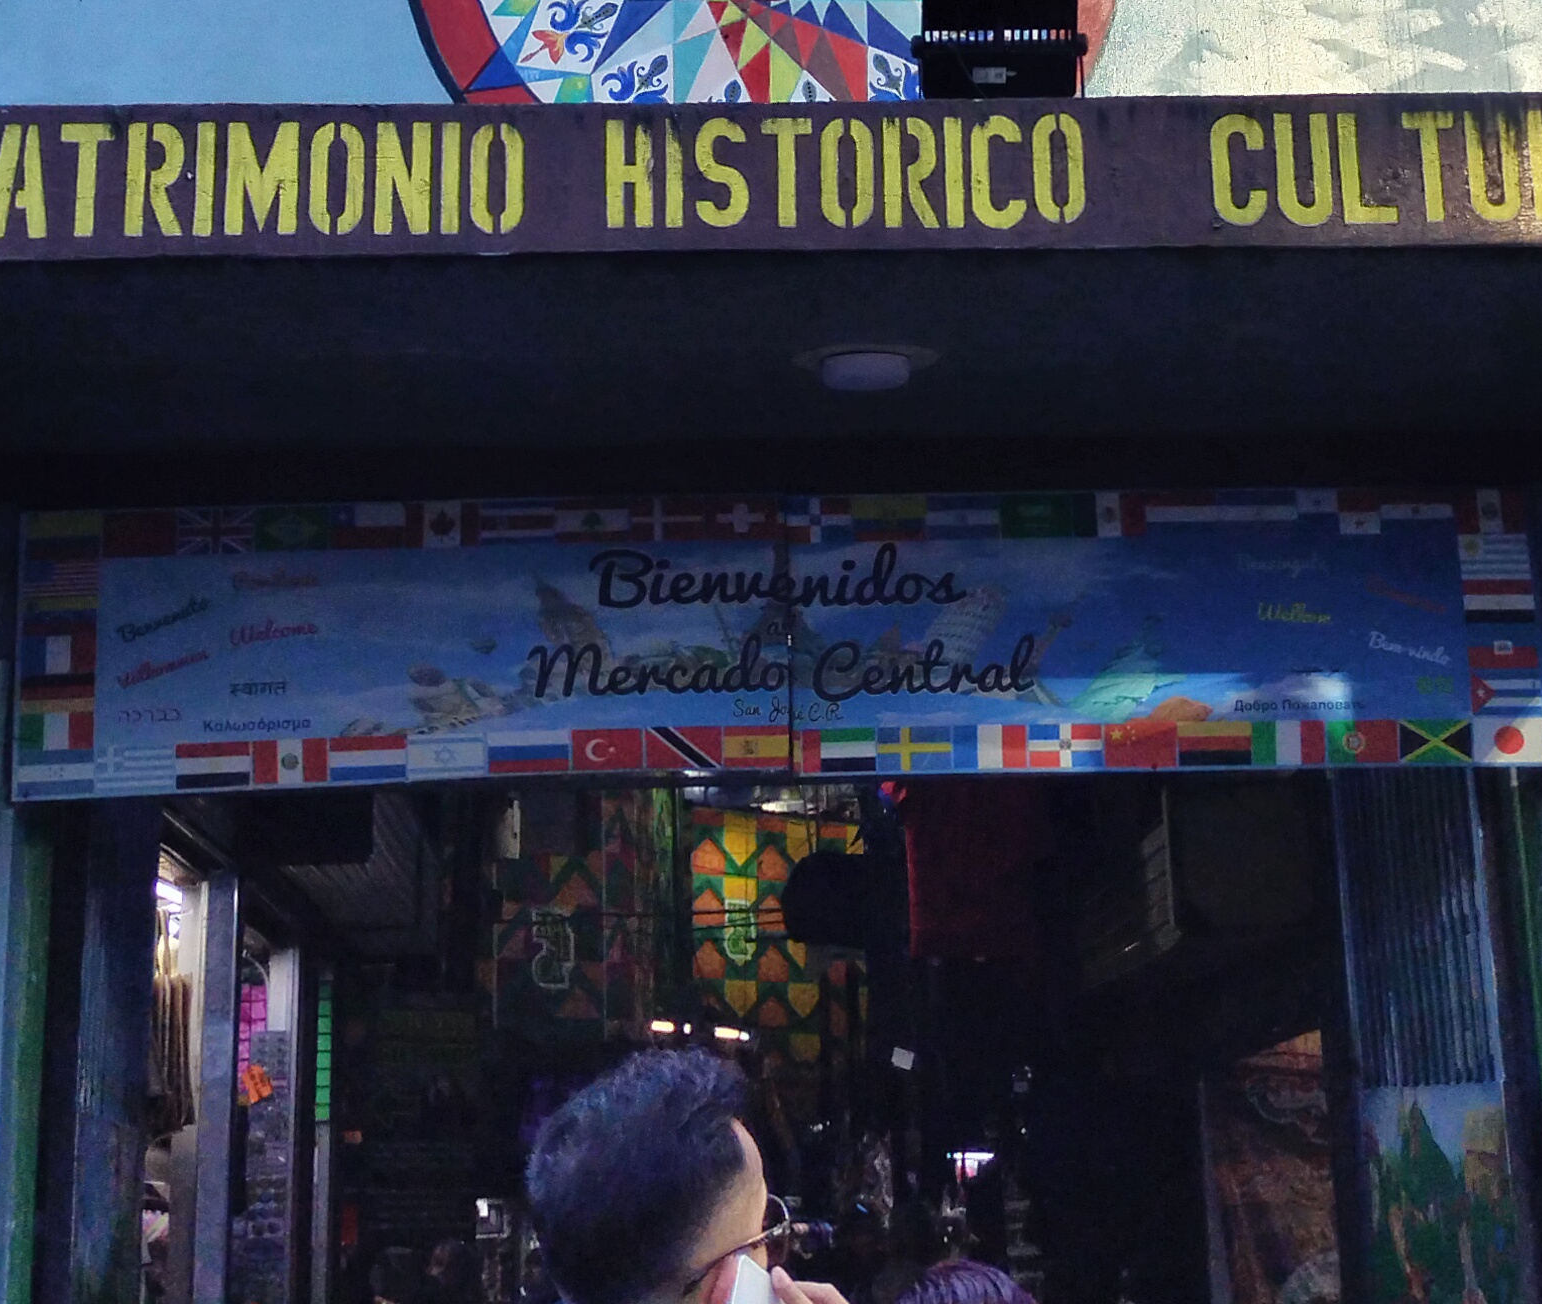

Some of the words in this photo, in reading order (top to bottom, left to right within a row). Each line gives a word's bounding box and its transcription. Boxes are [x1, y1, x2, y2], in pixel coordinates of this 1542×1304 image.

[605, 112, 1087, 230] HISTORICO
[589, 542, 967, 609] Bienvenidos
[230, 619, 317, 646] Welcome
[527, 634, 790, 699] Mercado
[813, 634, 1035, 703] Central
[733, 698, 761, 718] San
[769, 696, 805, 723] Joé
[1234, 698, 1278, 715] Добро
